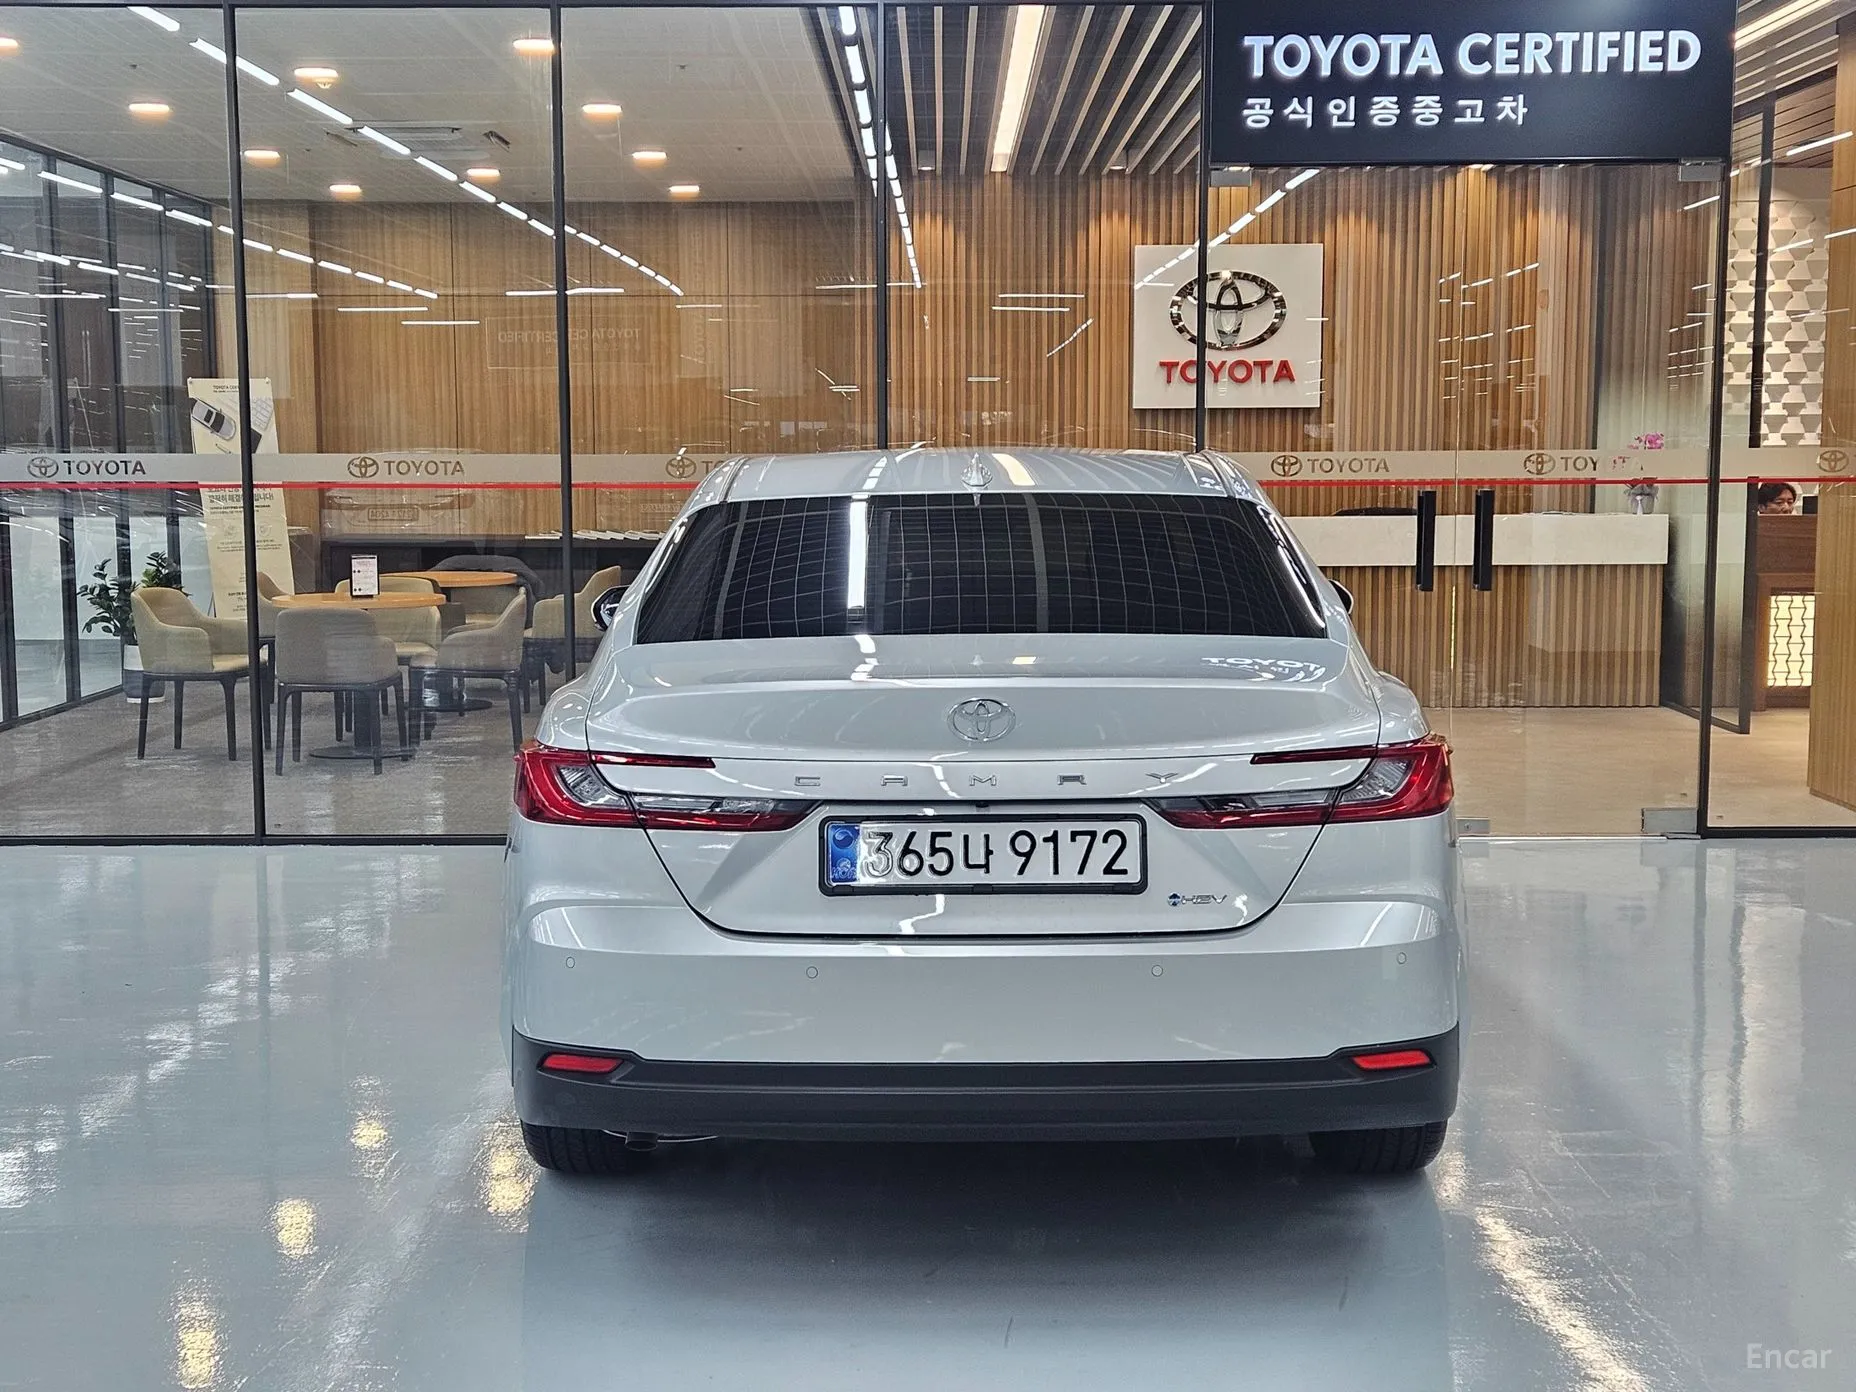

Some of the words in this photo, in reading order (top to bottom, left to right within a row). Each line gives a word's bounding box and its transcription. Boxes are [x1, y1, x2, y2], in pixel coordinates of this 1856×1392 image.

[1243, 34, 1443, 78] TOYOTA
[1458, 30, 1701, 74] CERTIFIED
[1159, 360, 1295, 383] TOYOTA
[63, 460, 146, 475] TOYOTA
[383, 460, 464, 475] TOYOTA
[1307, 458, 1389, 473] TOYOTA
[794, 773, 1179, 787] CAMRY
[866, 831, 993, 876] 365나
[1009, 829, 1128, 875] 9172
[1181, 894, 1228, 904] HEV
